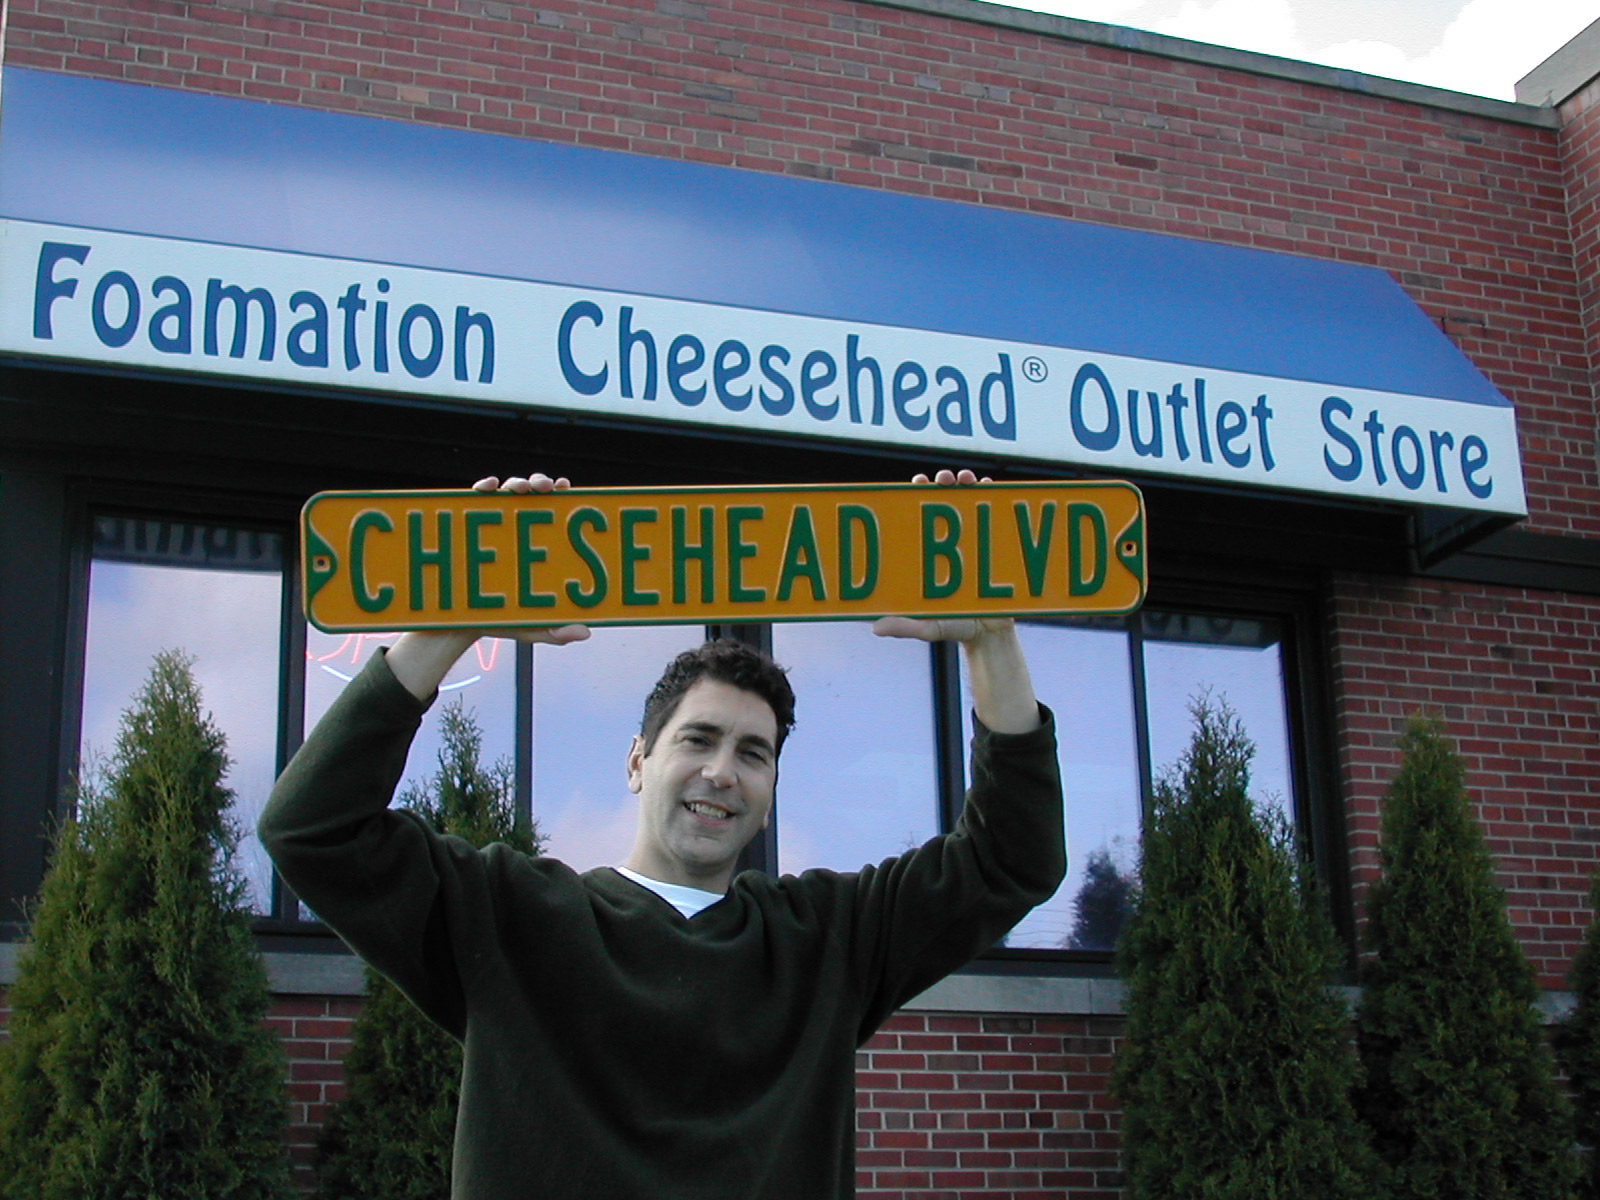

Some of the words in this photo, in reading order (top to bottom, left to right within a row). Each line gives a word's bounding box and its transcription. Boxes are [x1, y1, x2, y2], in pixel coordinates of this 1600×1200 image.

[34, 241, 494, 384] Foamation
[1070, 363, 1275, 471] Outlet
[1321, 396, 1493, 498] Store
[349, 503, 880, 614] CHEESEHEAD
[921, 502, 1108, 600] BLVD
